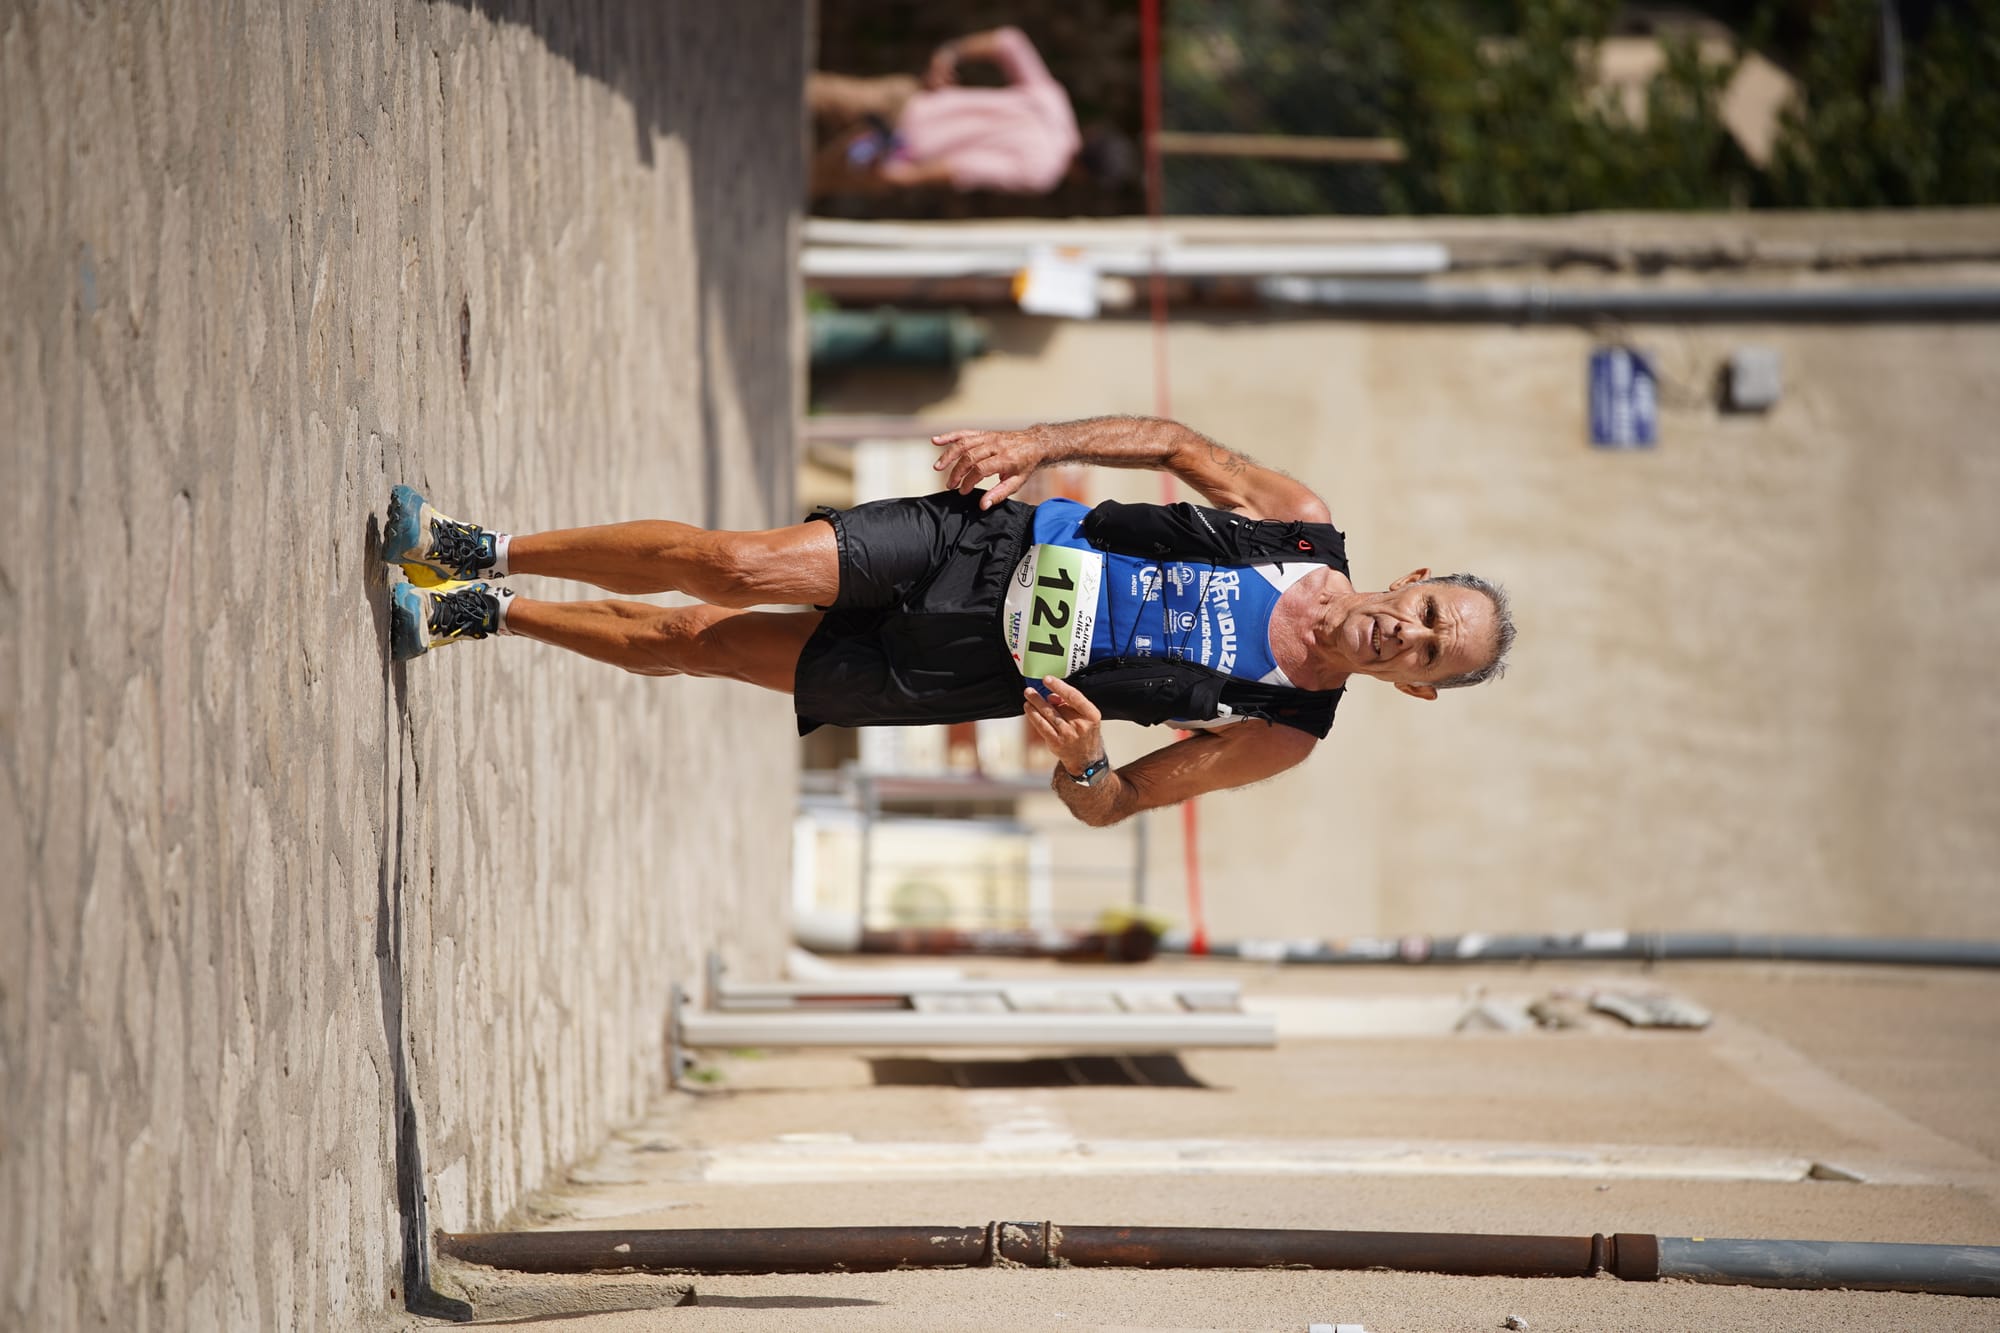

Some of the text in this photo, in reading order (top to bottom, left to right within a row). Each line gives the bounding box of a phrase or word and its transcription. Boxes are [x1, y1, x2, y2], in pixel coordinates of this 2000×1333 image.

[1192, 504, 1216, 534] ALOMON
[1028, 568, 1074, 656] 121
[1074, 610, 1083, 639] vallées
[1078, 616, 1092, 657] Challenge
